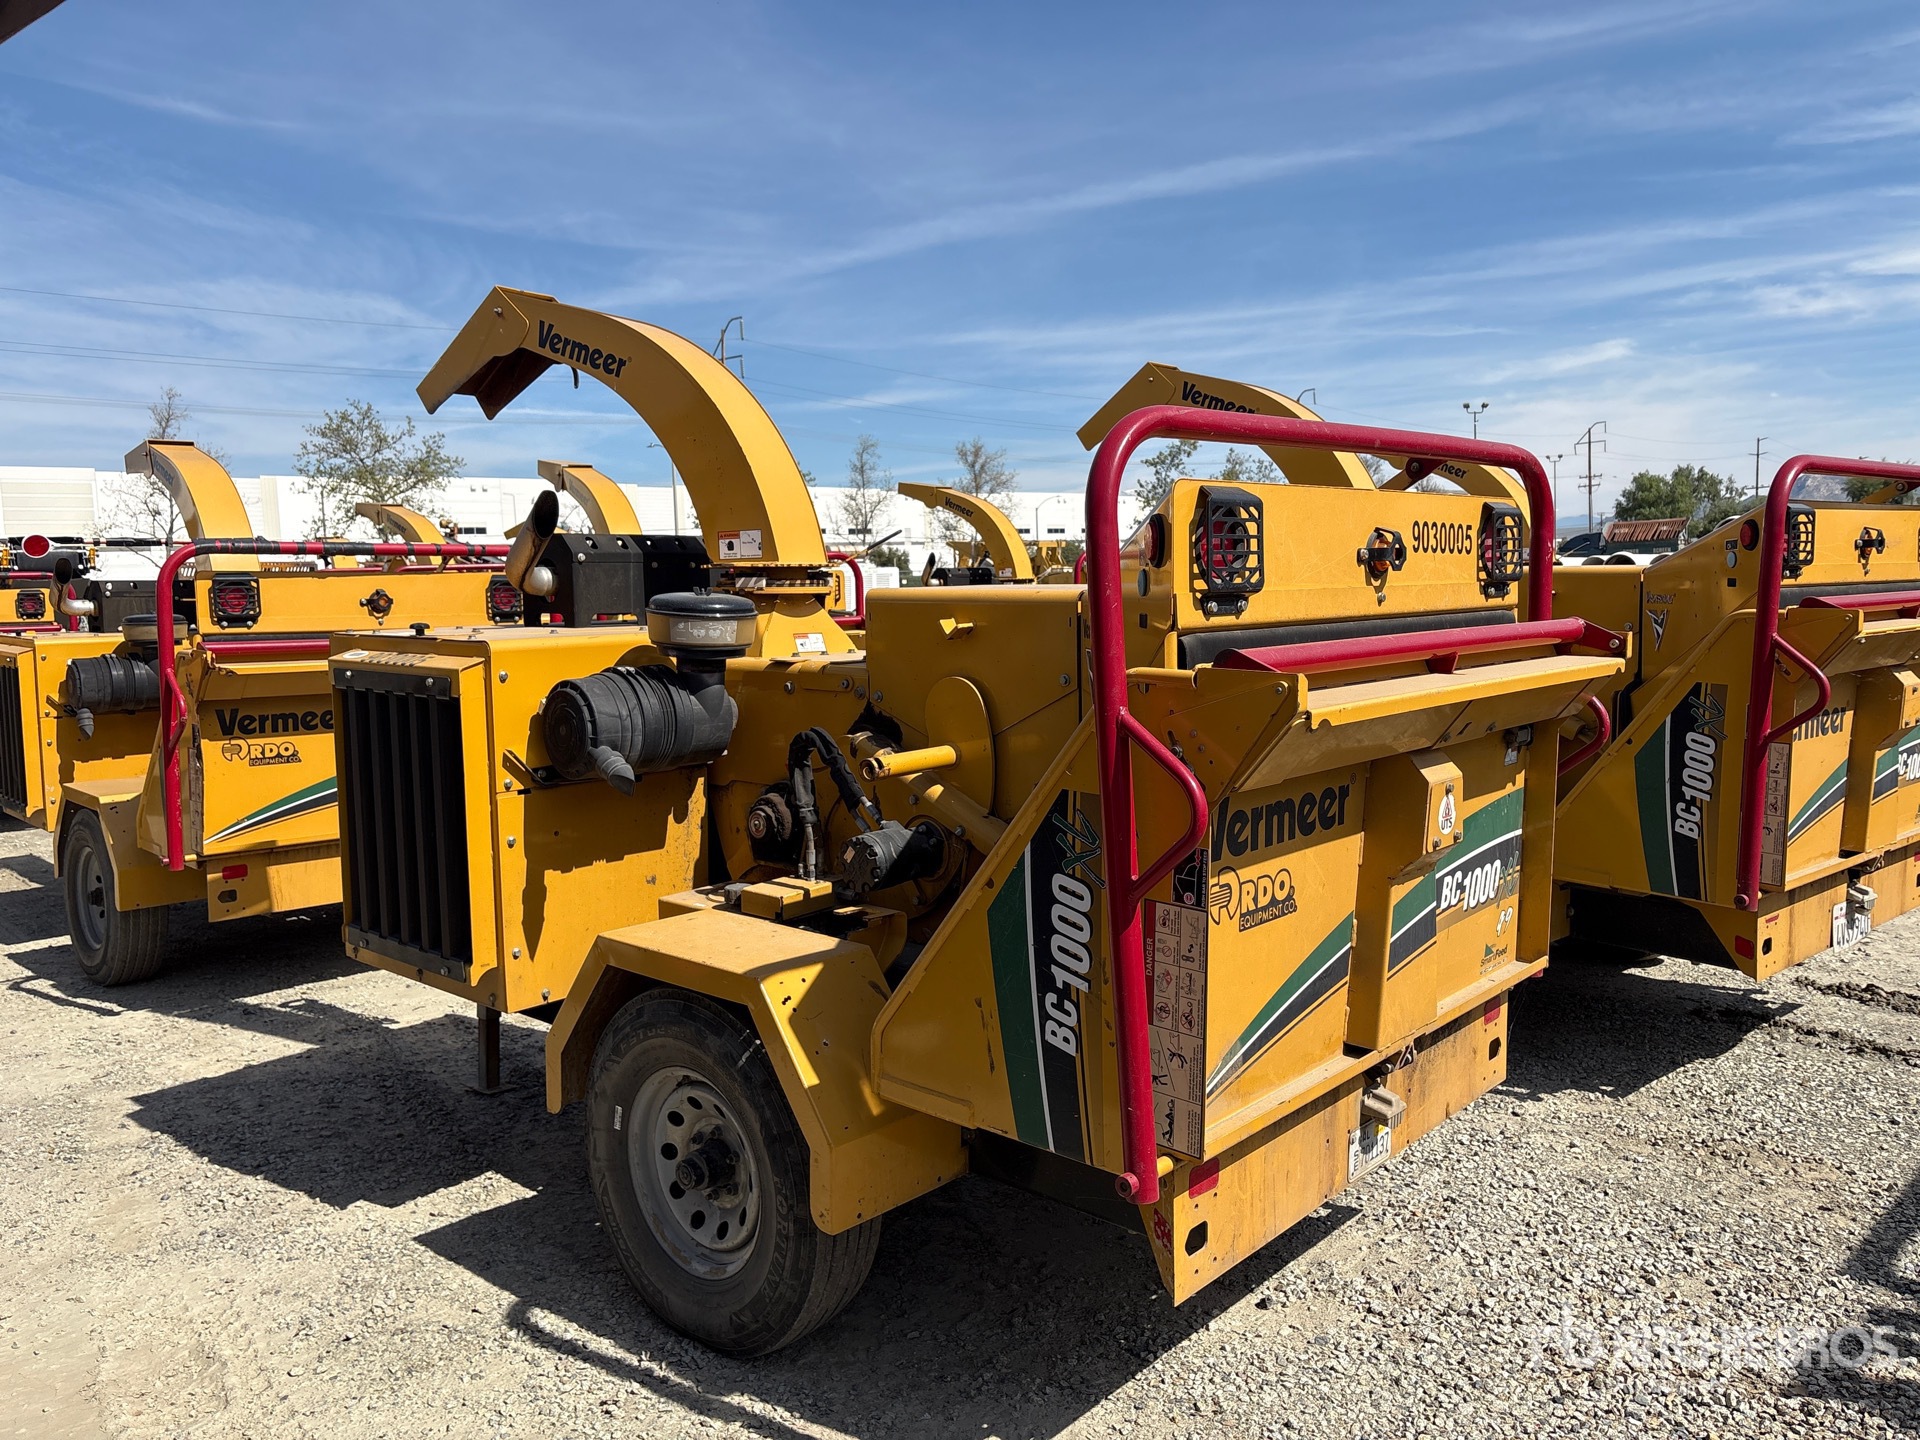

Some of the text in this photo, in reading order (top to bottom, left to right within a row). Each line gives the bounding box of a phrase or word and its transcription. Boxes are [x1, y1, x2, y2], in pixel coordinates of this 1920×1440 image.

[538, 320, 627, 378] Vermeer
[945, 496, 974, 518] Vermeer
[1412, 520, 1473, 555] 9030005
[215, 708, 334, 737] Vermee
[249, 741, 296, 759] RDO
[249, 758, 288, 766] EQUIPMENT
[1211, 784, 1350, 863] Vermeer
[1441, 819, 1453, 831] UTS
[1240, 868, 1292, 914] RDO
[1240, 905, 1283, 930] EQUIPMENT
[1145, 937, 1154, 976] DANGER
